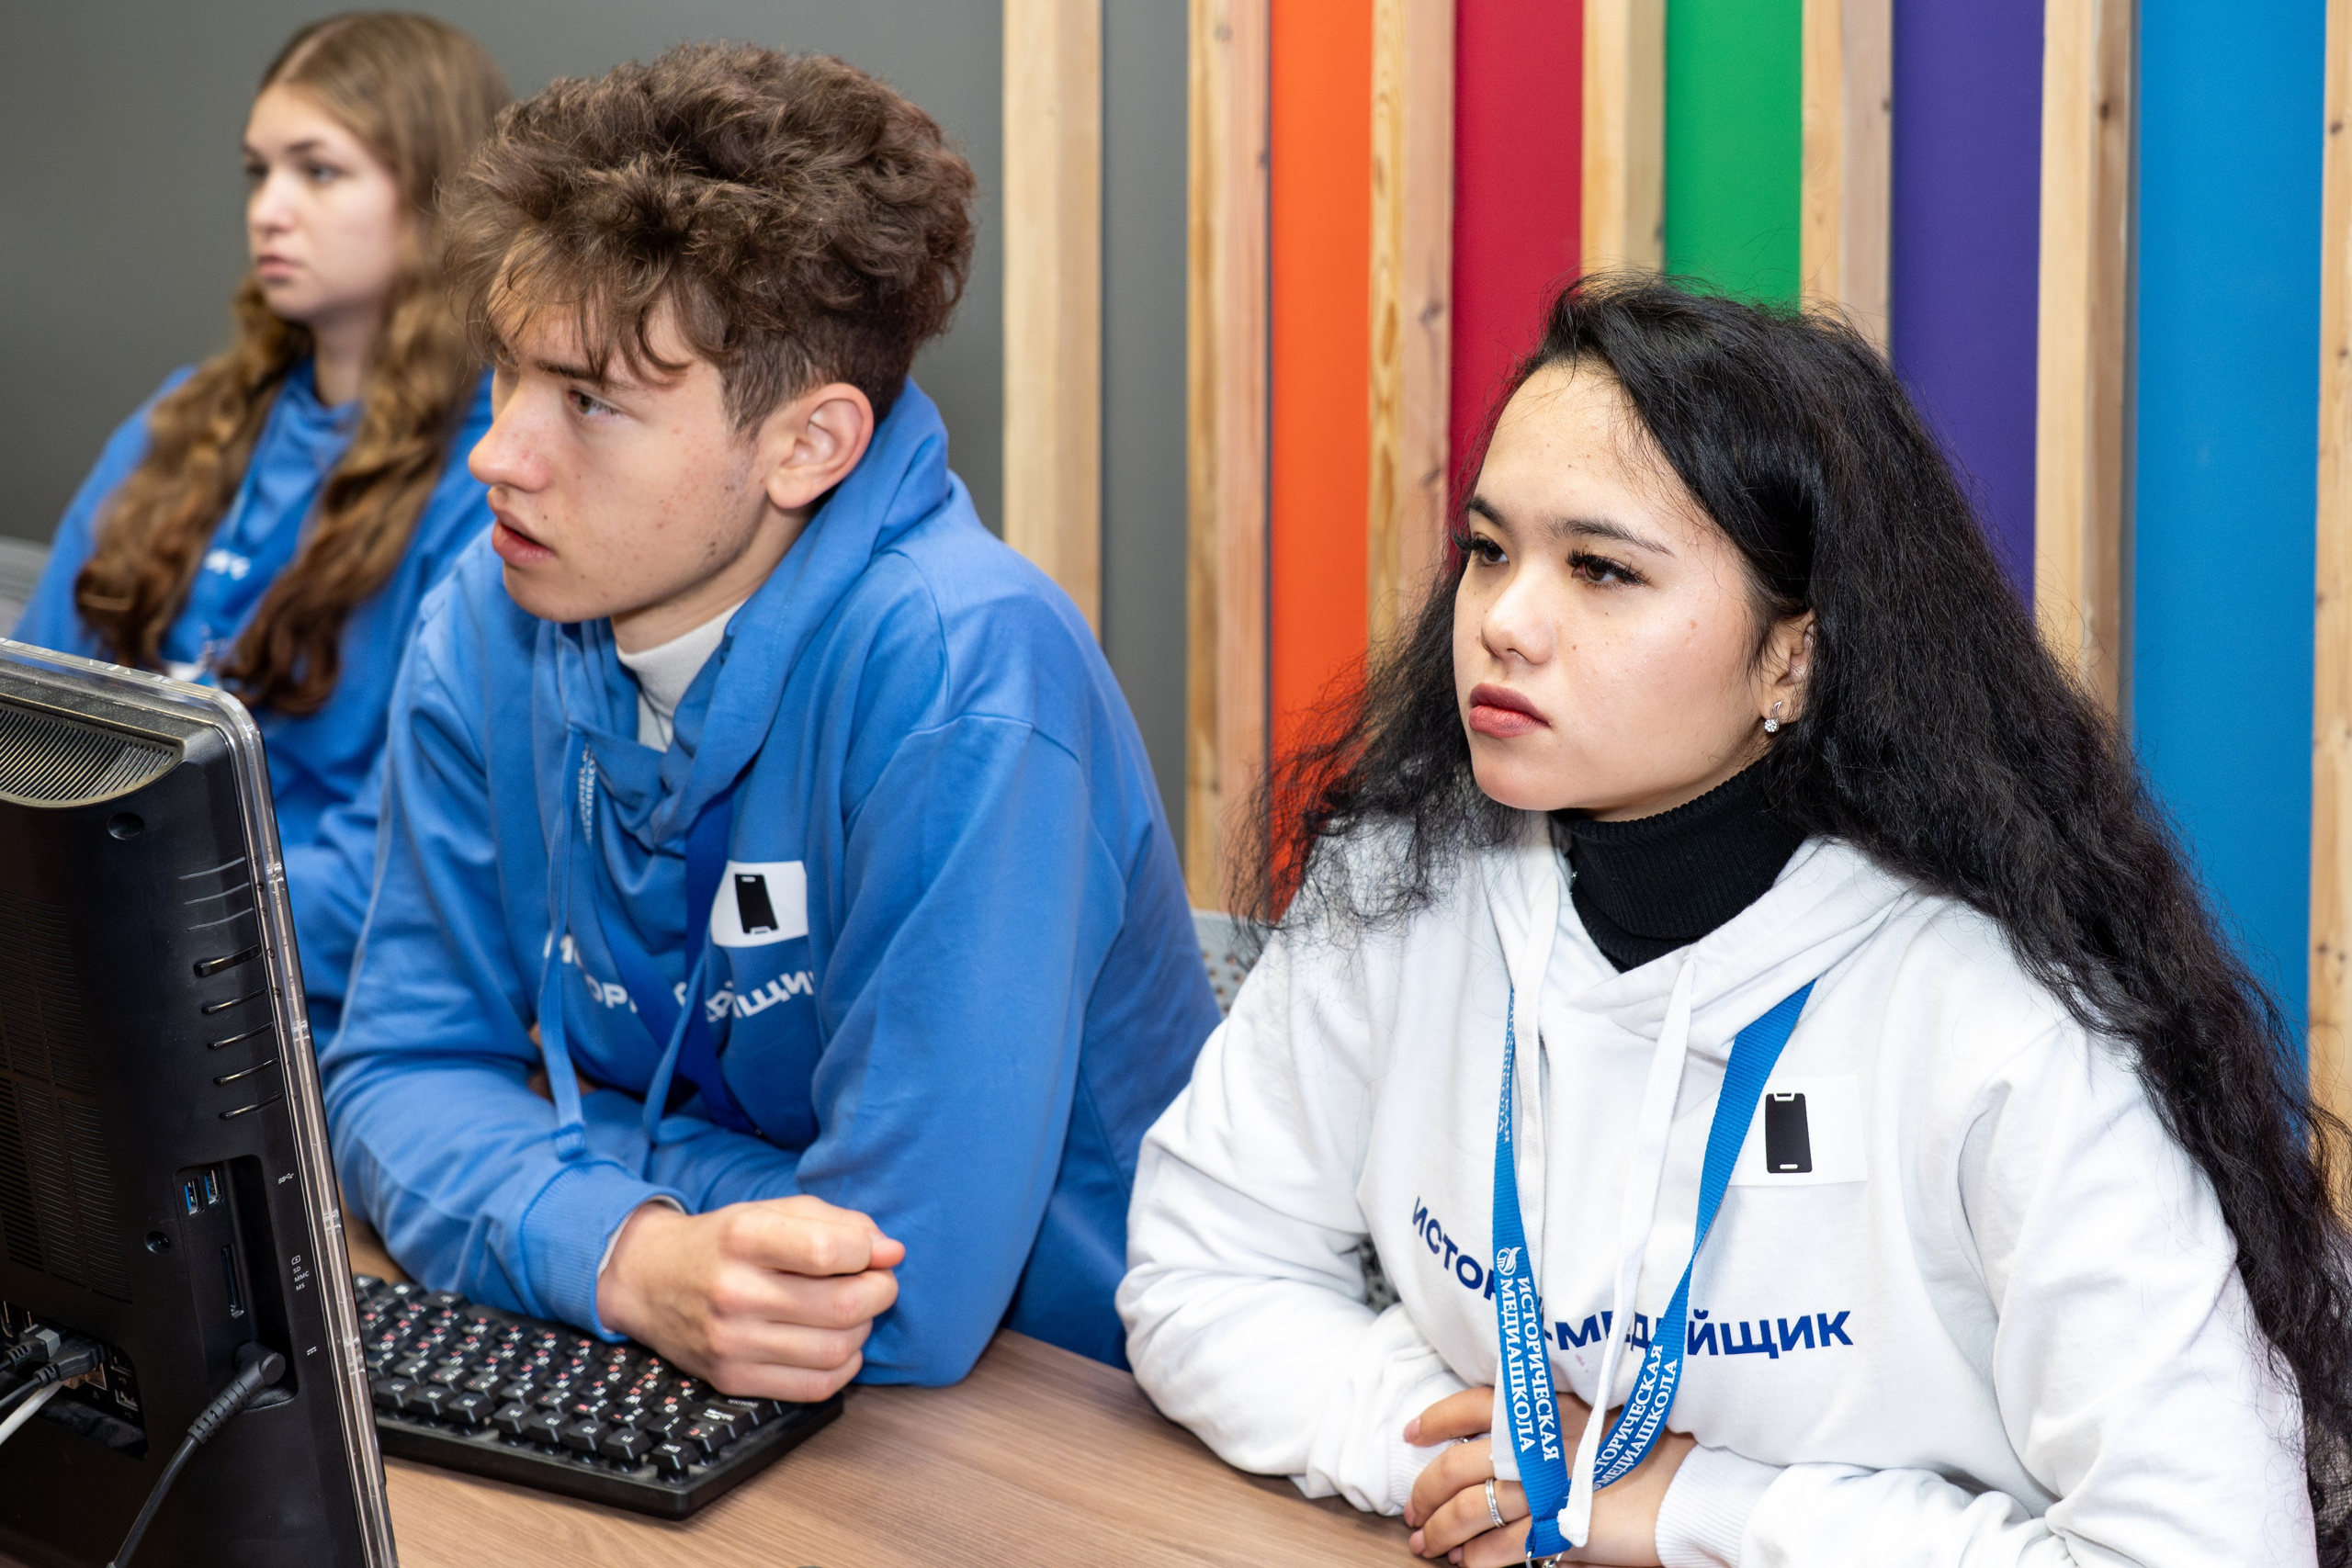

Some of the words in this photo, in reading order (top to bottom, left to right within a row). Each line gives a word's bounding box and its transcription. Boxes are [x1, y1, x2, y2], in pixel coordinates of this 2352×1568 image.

[1499, 1278, 1536, 1453] МЕДИАШКОЛА
[1517, 1276, 1559, 1462] ИСТОРИЧЕСКАЯ
[1592, 1344, 1663, 1483] СТОРИЧЕСКАЯ
[1601, 1359, 1678, 1484] МЕДИАШКОЛА
